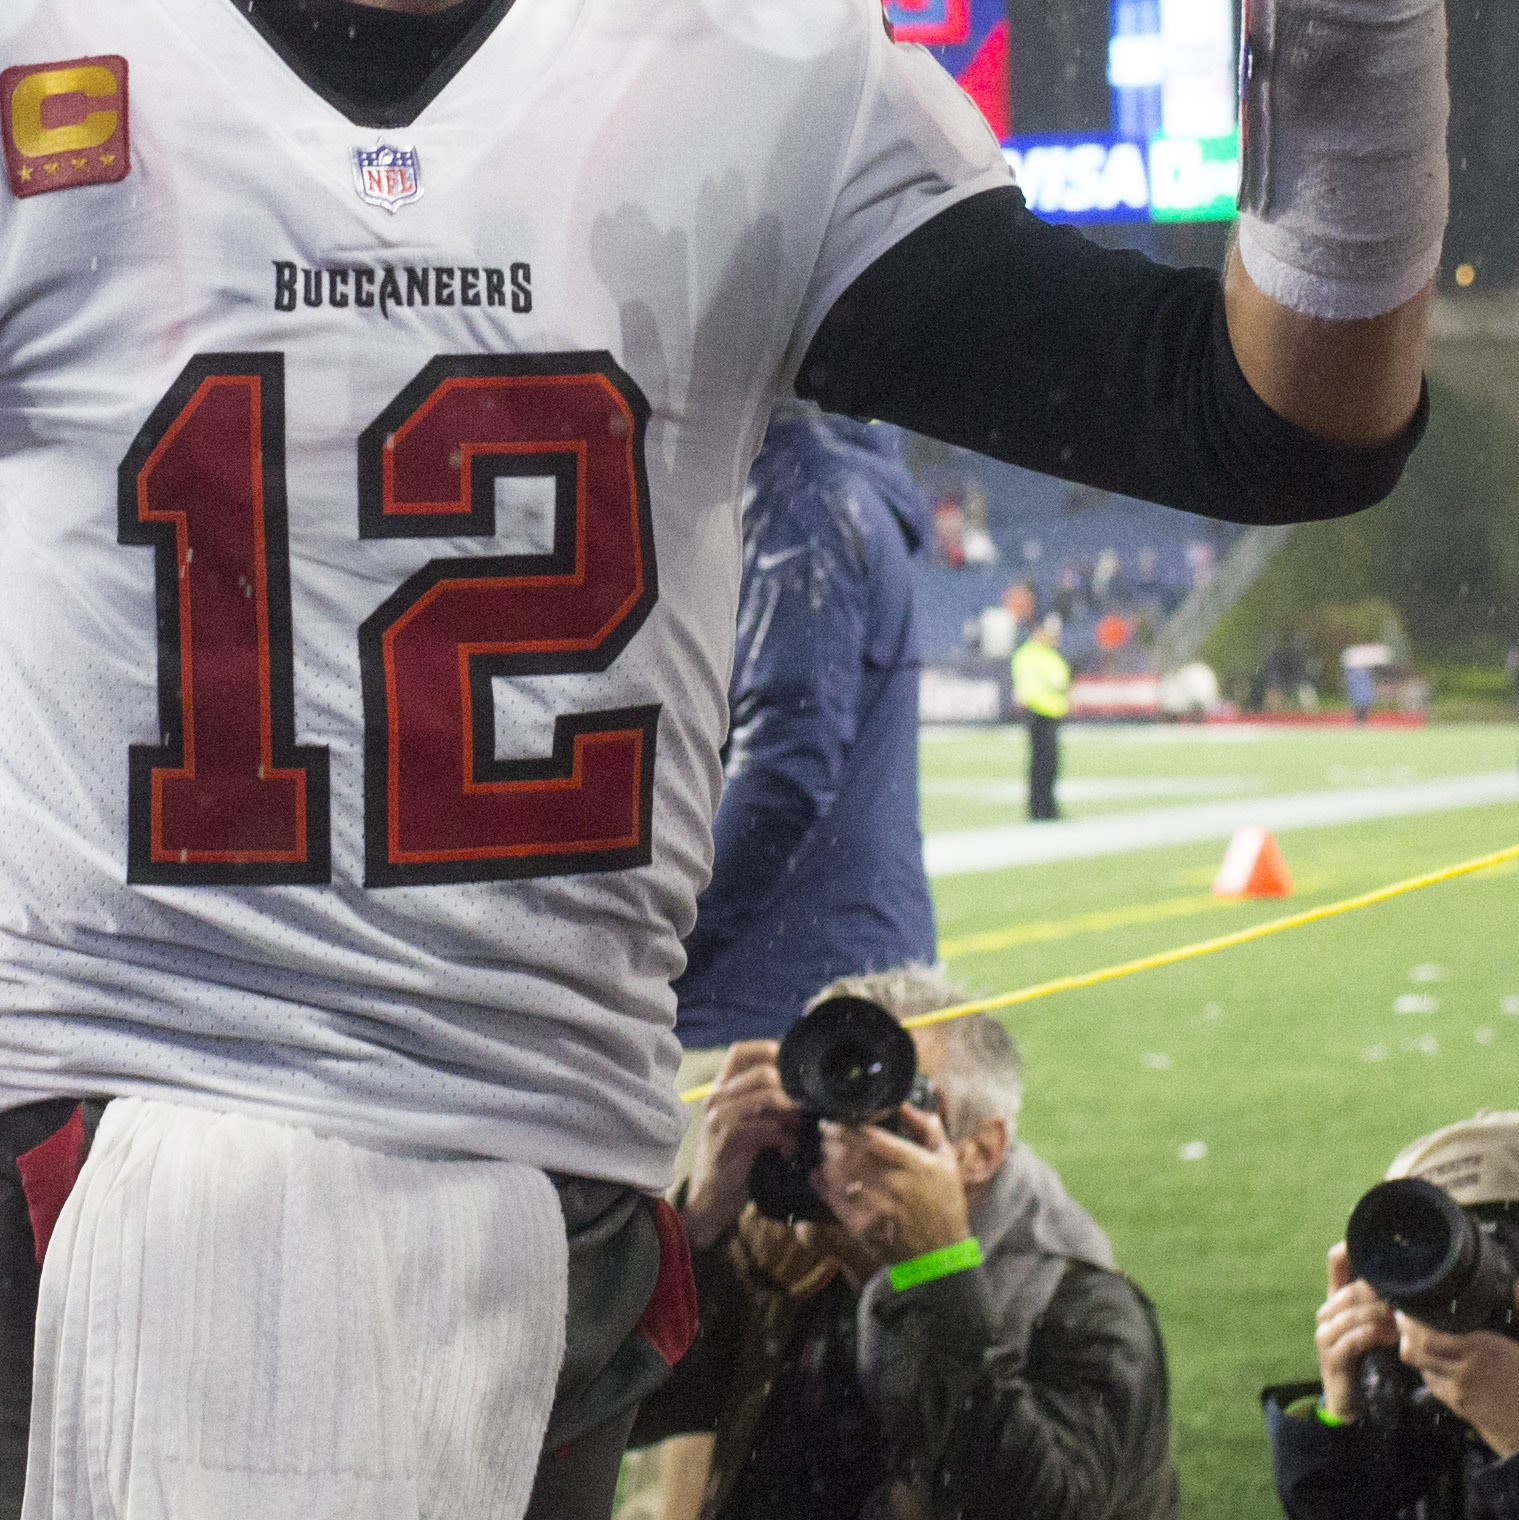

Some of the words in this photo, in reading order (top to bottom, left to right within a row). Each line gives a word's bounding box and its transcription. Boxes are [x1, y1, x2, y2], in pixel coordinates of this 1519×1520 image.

[11, 65, 118, 158] C
[367, 167, 414, 196] NFL
[271, 260, 533, 320] BUCCANEERS
[118, 350, 661, 887] 12
